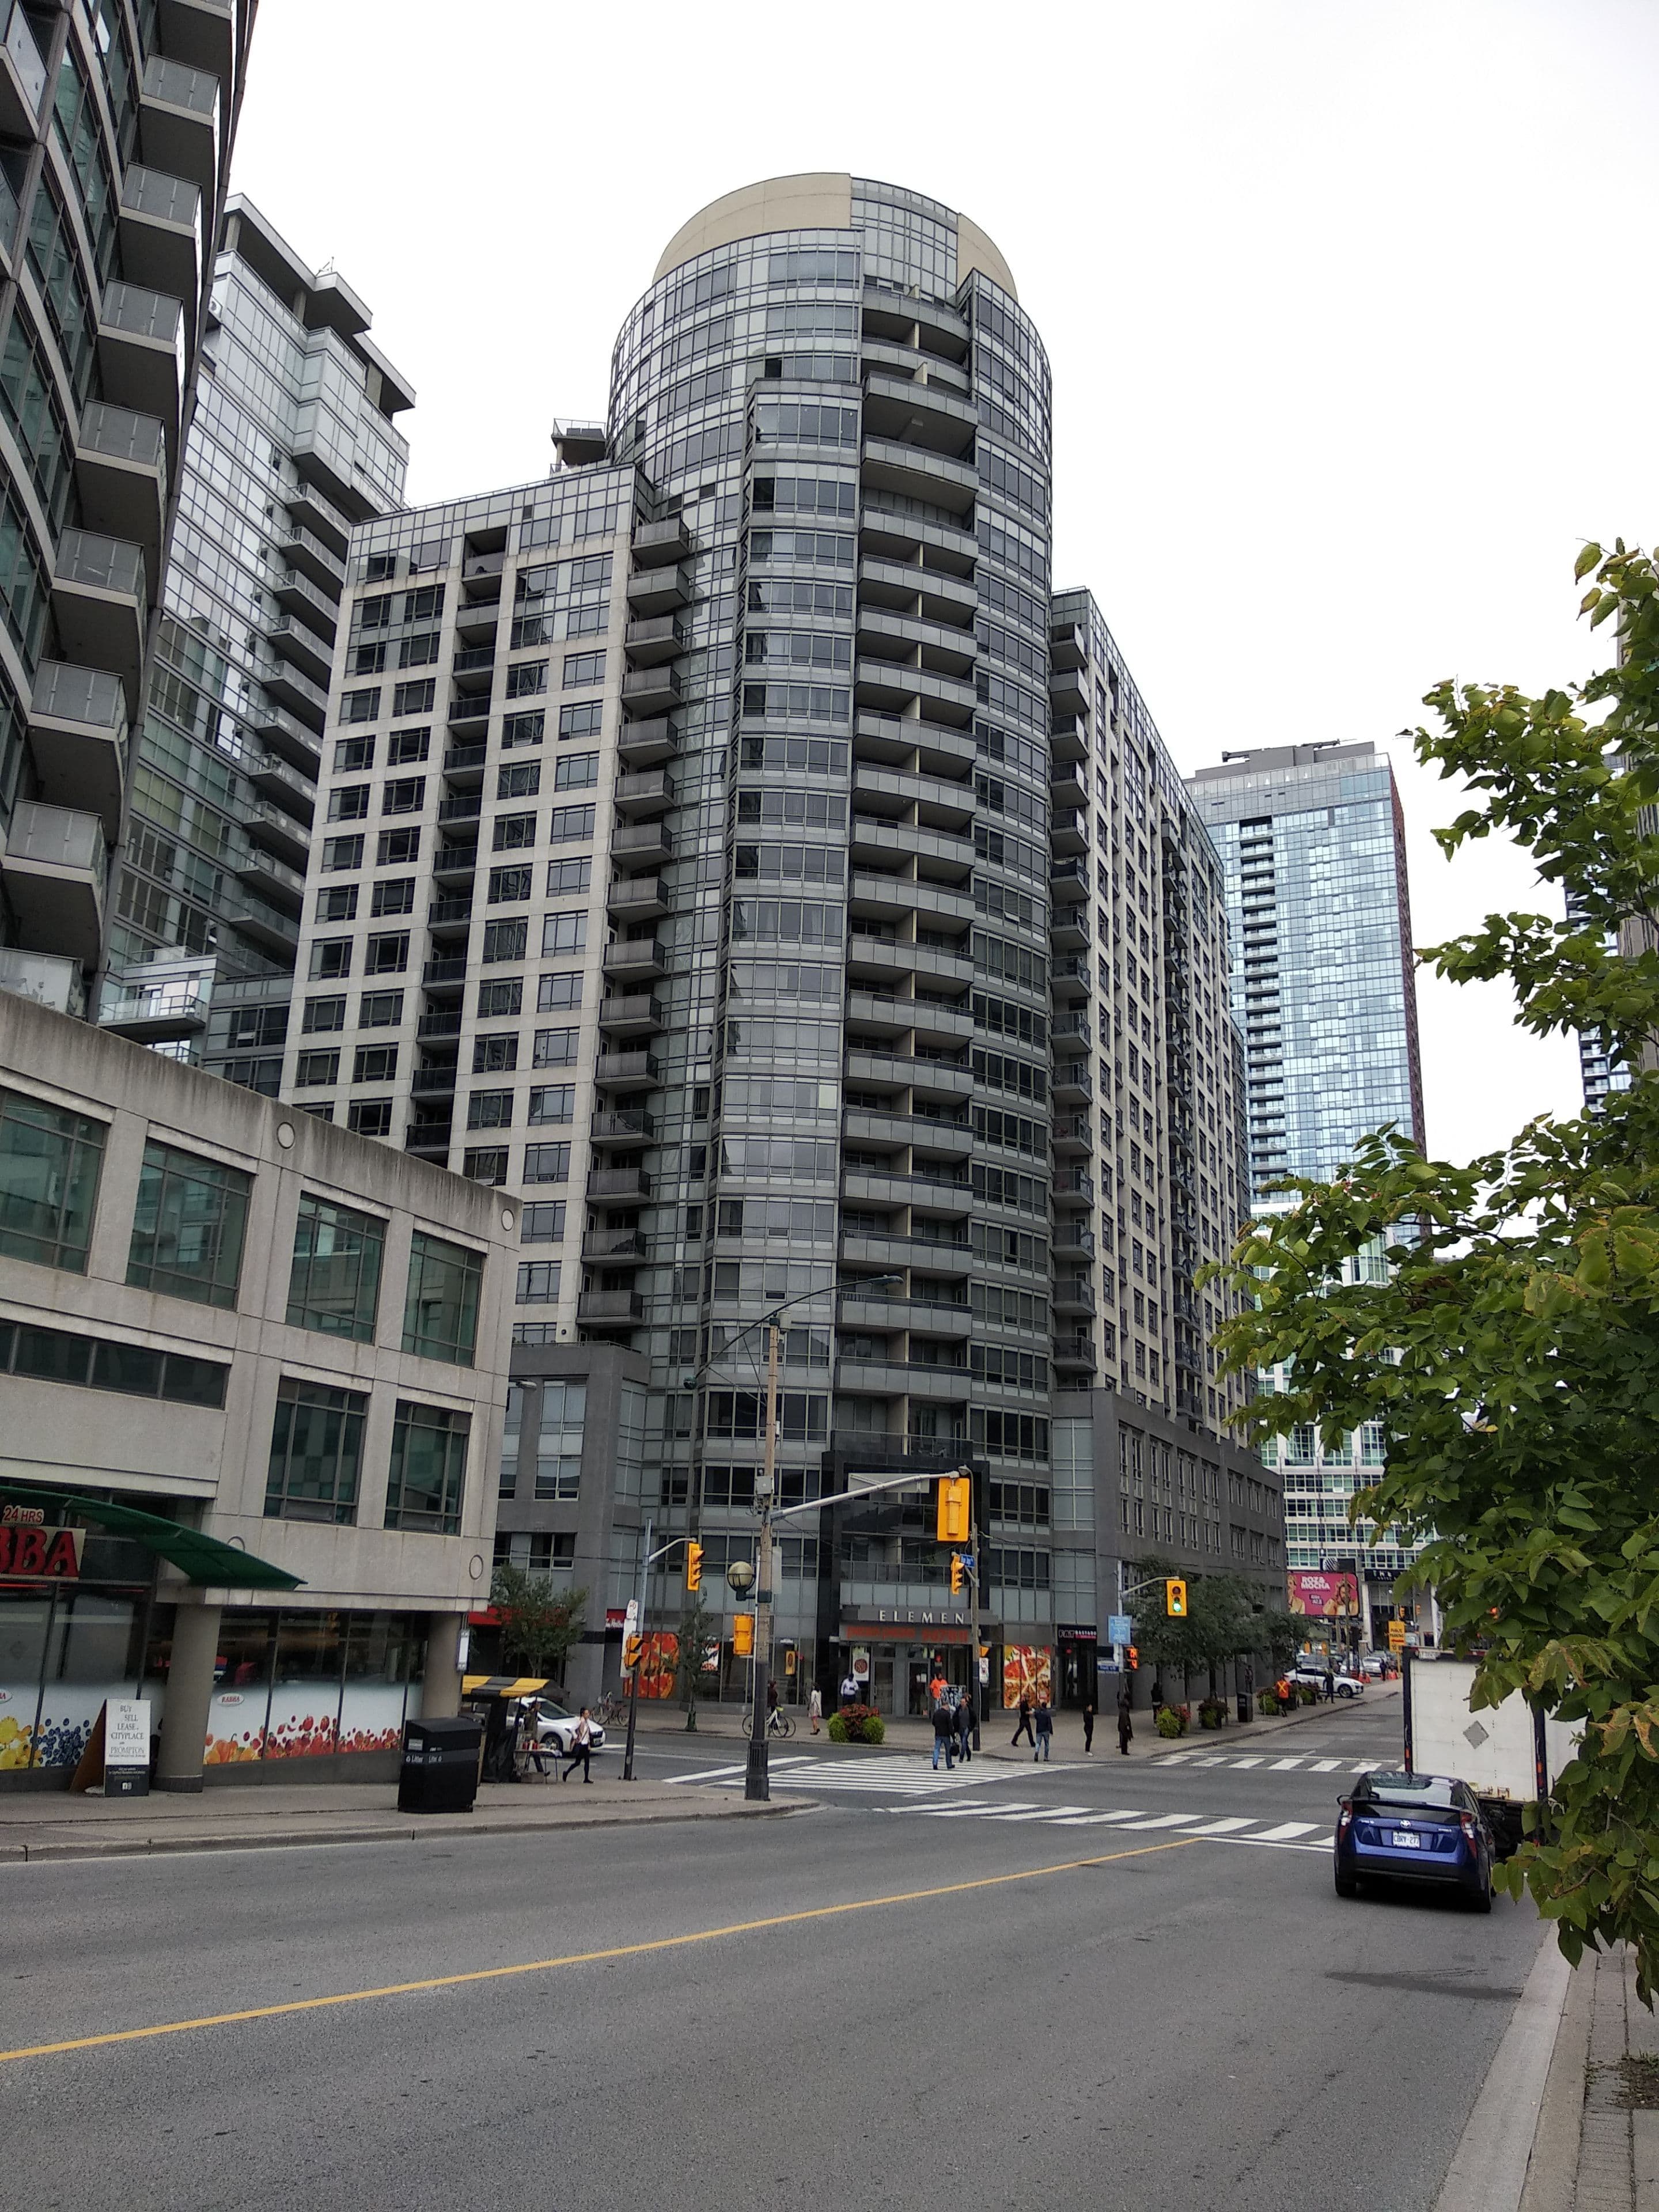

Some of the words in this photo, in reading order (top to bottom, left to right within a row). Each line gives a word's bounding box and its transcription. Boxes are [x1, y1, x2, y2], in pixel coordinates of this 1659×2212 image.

[3, 1507, 19, 1521] 24
[21, 1510, 43, 1523] HRS
[879, 1609, 964, 1624] ELEMEN
[411, 1755, 423, 1763] Litter
